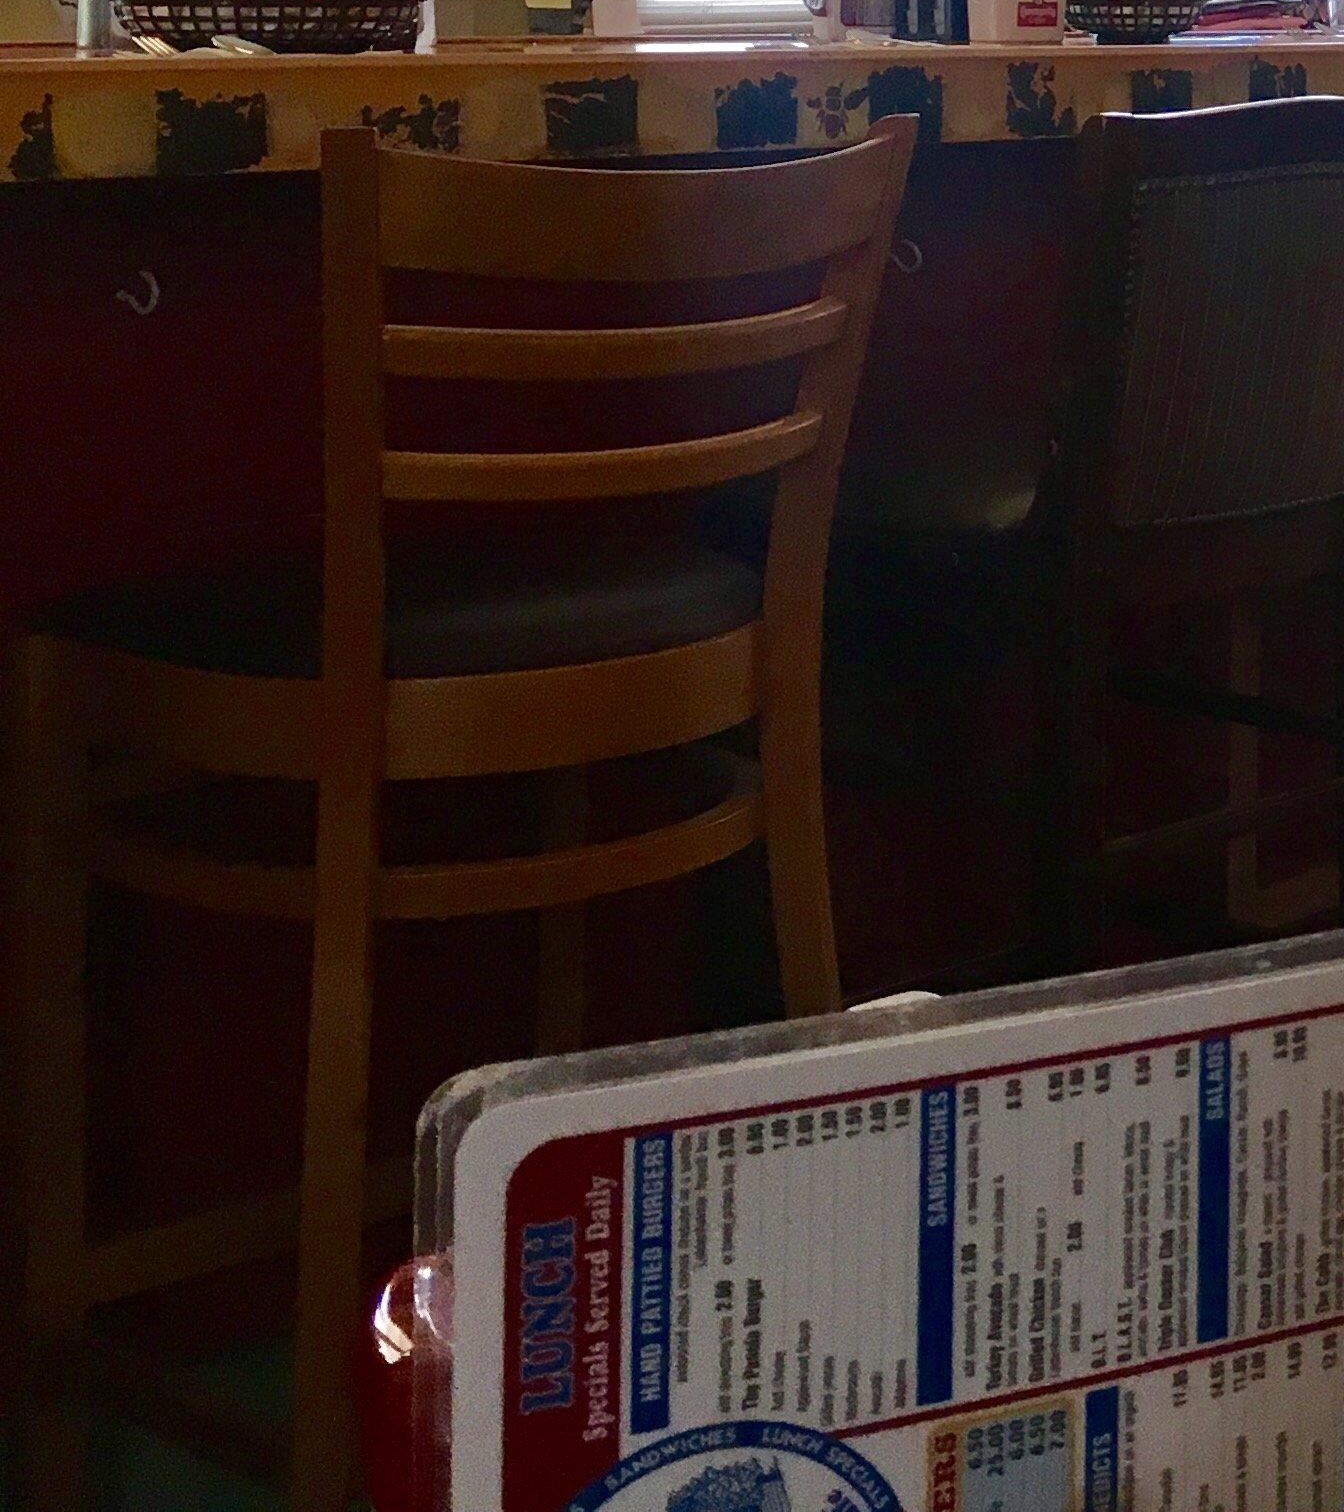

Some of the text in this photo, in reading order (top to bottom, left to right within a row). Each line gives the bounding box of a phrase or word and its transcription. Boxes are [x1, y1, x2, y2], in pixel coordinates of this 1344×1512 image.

[1205, 1040, 1224, 1120] SALADS
[926, 1090, 950, 1227] SANDWICHES
[519, 1216, 579, 1415] LUNCH
[581, 1174, 618, 1441] Specials Served Daily
[640, 1137, 667, 1402] HAND PATTIED BURGERS
[605, 1425, 739, 1491] SANDWICHES
[760, 1424, 824, 1456] LUNCH
[1092, 1433, 1112, 1504] EDICTS
